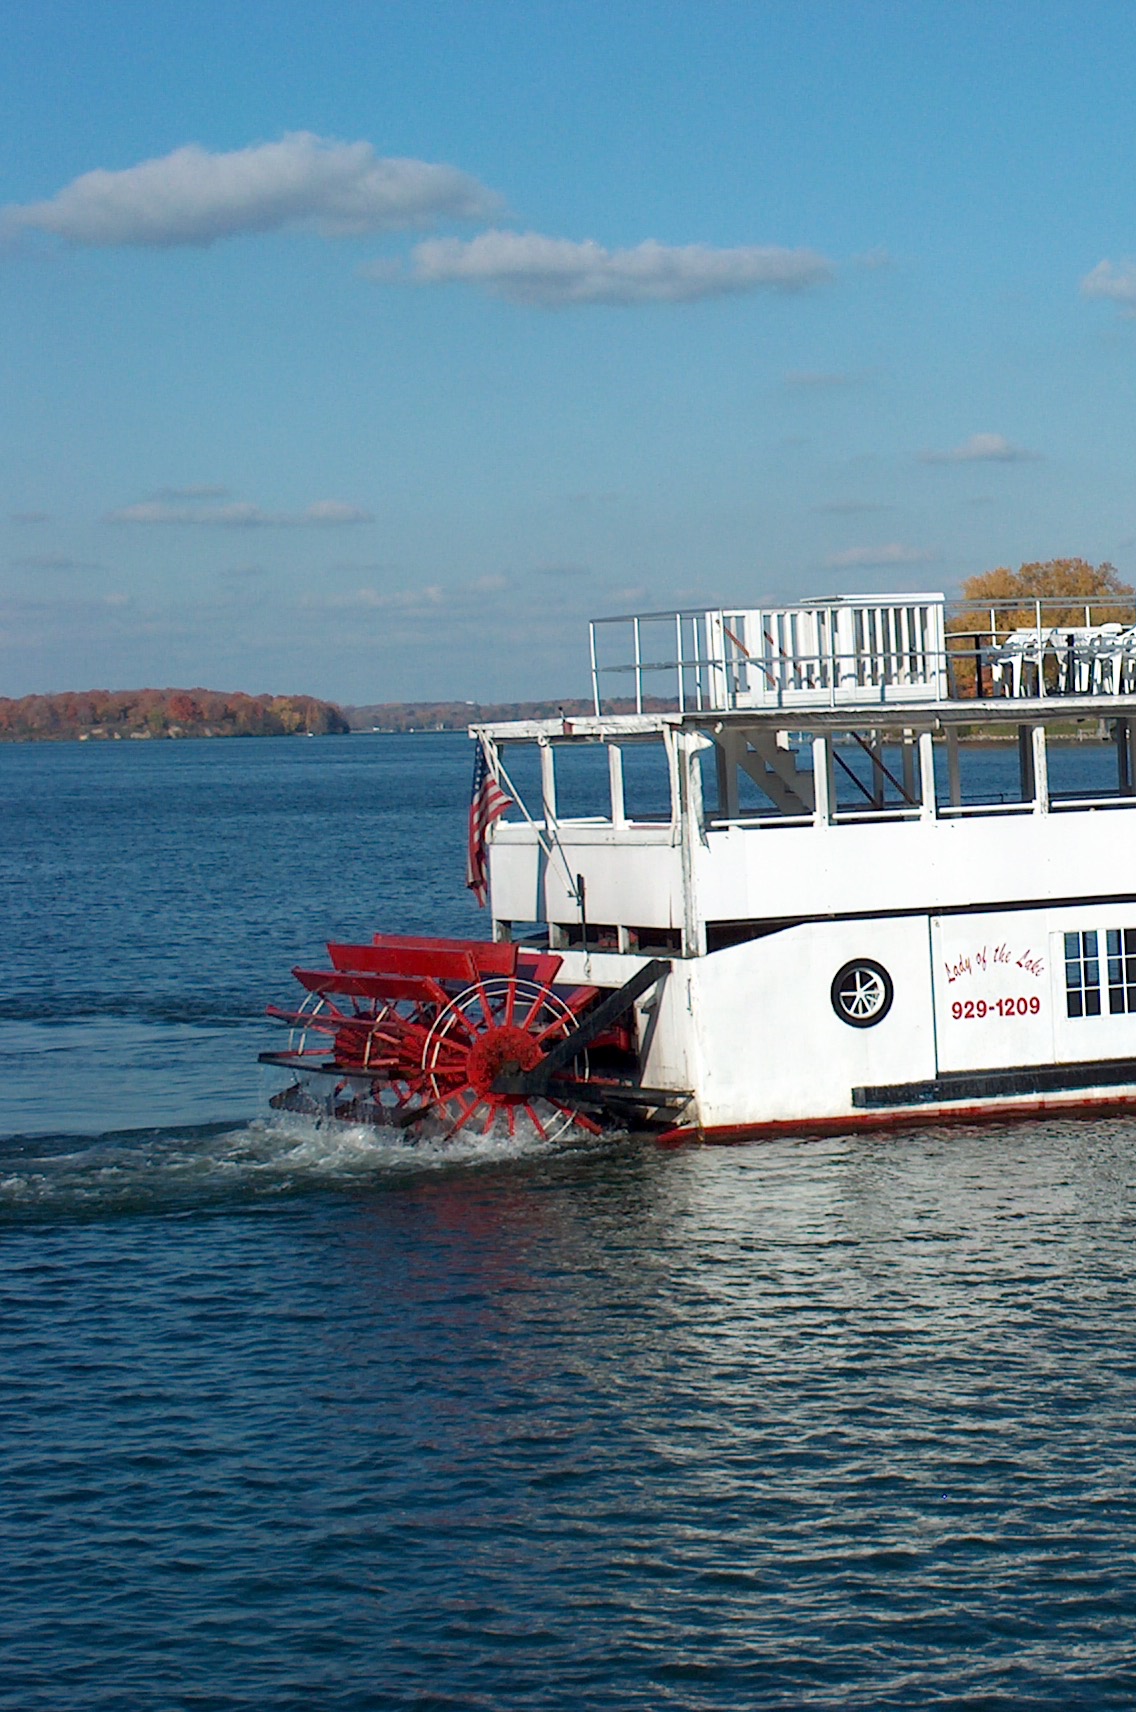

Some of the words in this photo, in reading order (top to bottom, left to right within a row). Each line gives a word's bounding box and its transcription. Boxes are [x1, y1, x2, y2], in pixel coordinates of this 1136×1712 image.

[945, 954, 972, 983] Lady
[976, 945, 987, 971] of
[993, 943, 1011, 964] the
[1015, 949, 1045, 977] Lake
[952, 996, 1040, 1019] 929-1209
